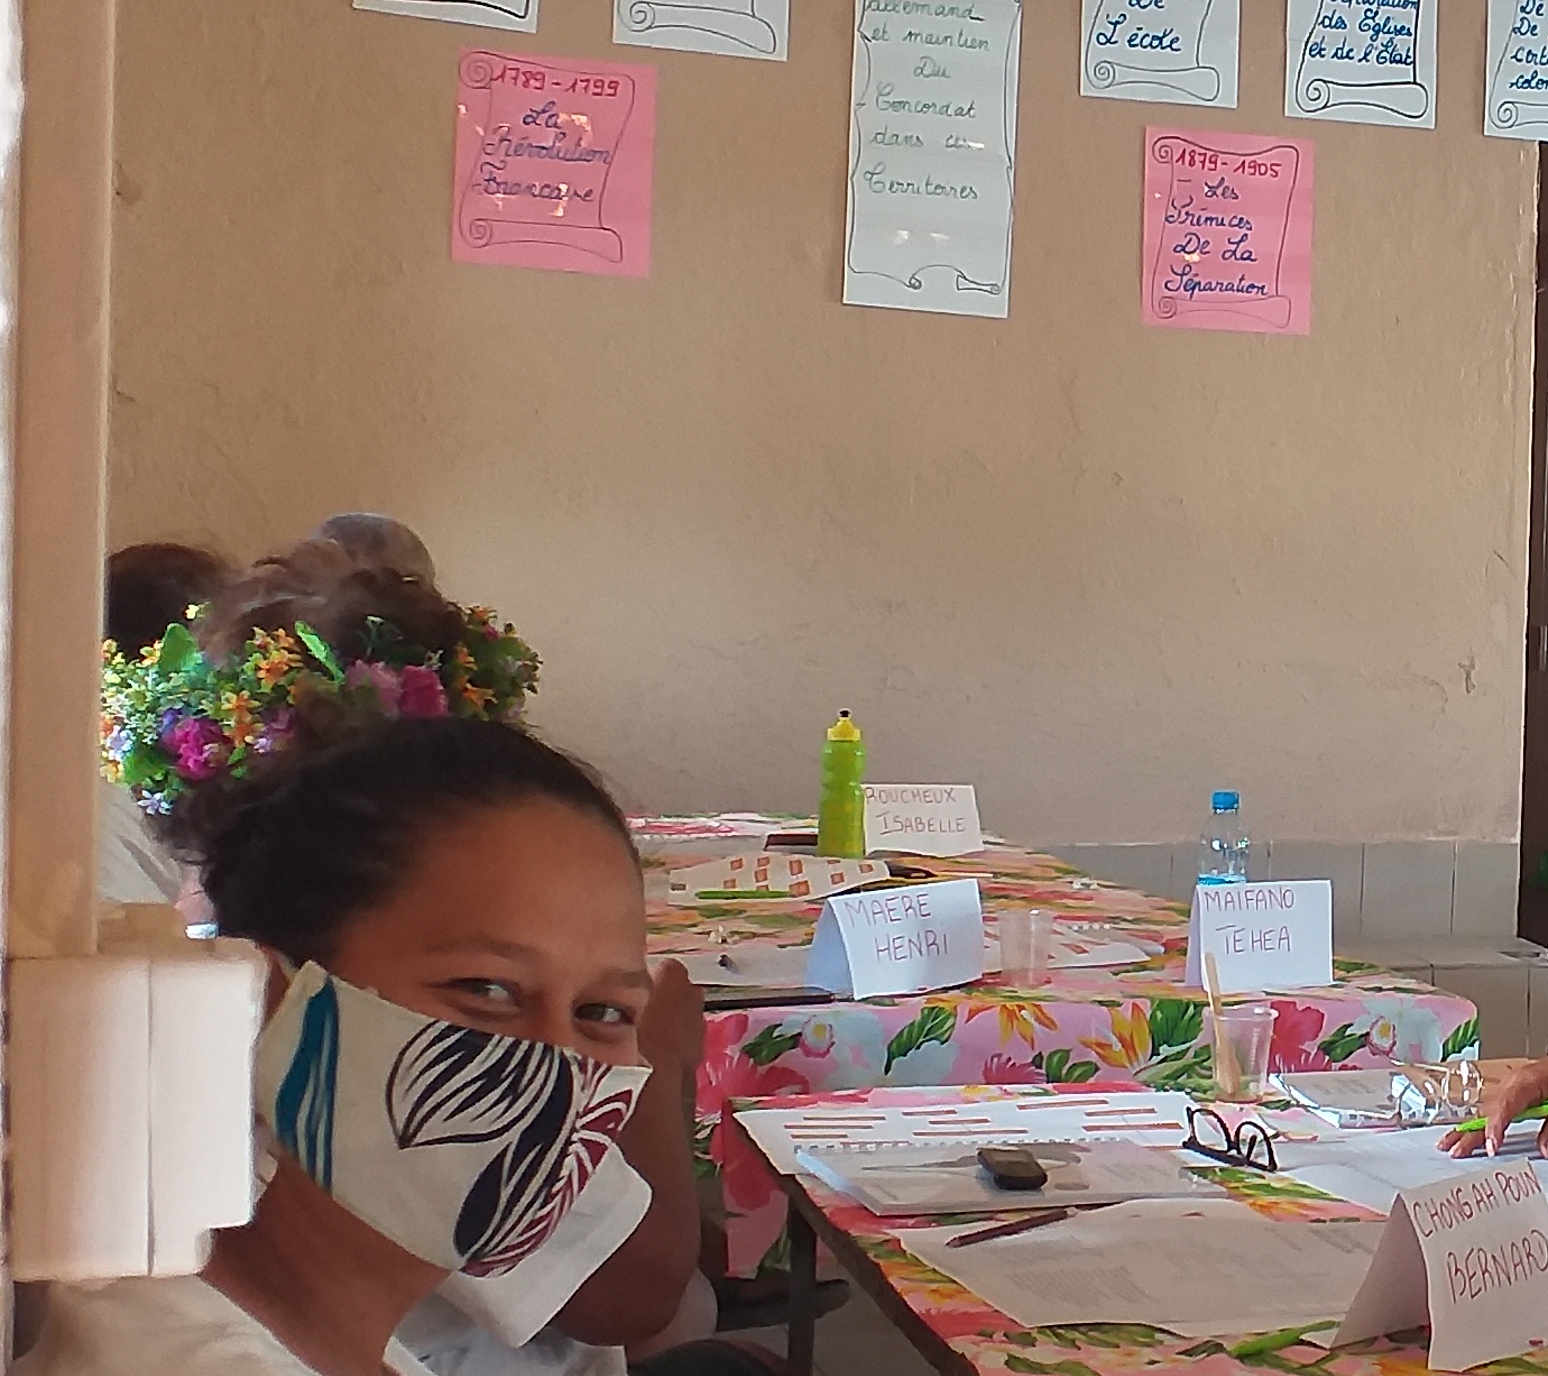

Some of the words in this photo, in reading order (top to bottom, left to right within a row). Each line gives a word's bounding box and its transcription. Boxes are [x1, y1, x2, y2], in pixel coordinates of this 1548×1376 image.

[871, 27, 890, 43] et
[1512, 17, 1538, 37] De
[1309, 36, 1326, 59] et
[1332, 38, 1354, 60] de
[875, 82, 977, 119] Concordat
[870, 125, 924, 148] dans
[1173, 232, 1211, 256] De
[876, 811, 966, 835] ISABELLE
[844, 893, 931, 928] MAERE
[1204, 886, 1295, 911] MAIFANO
[874, 929, 948, 963] HENRI
[1216, 924, 1291, 955] TEHEA
